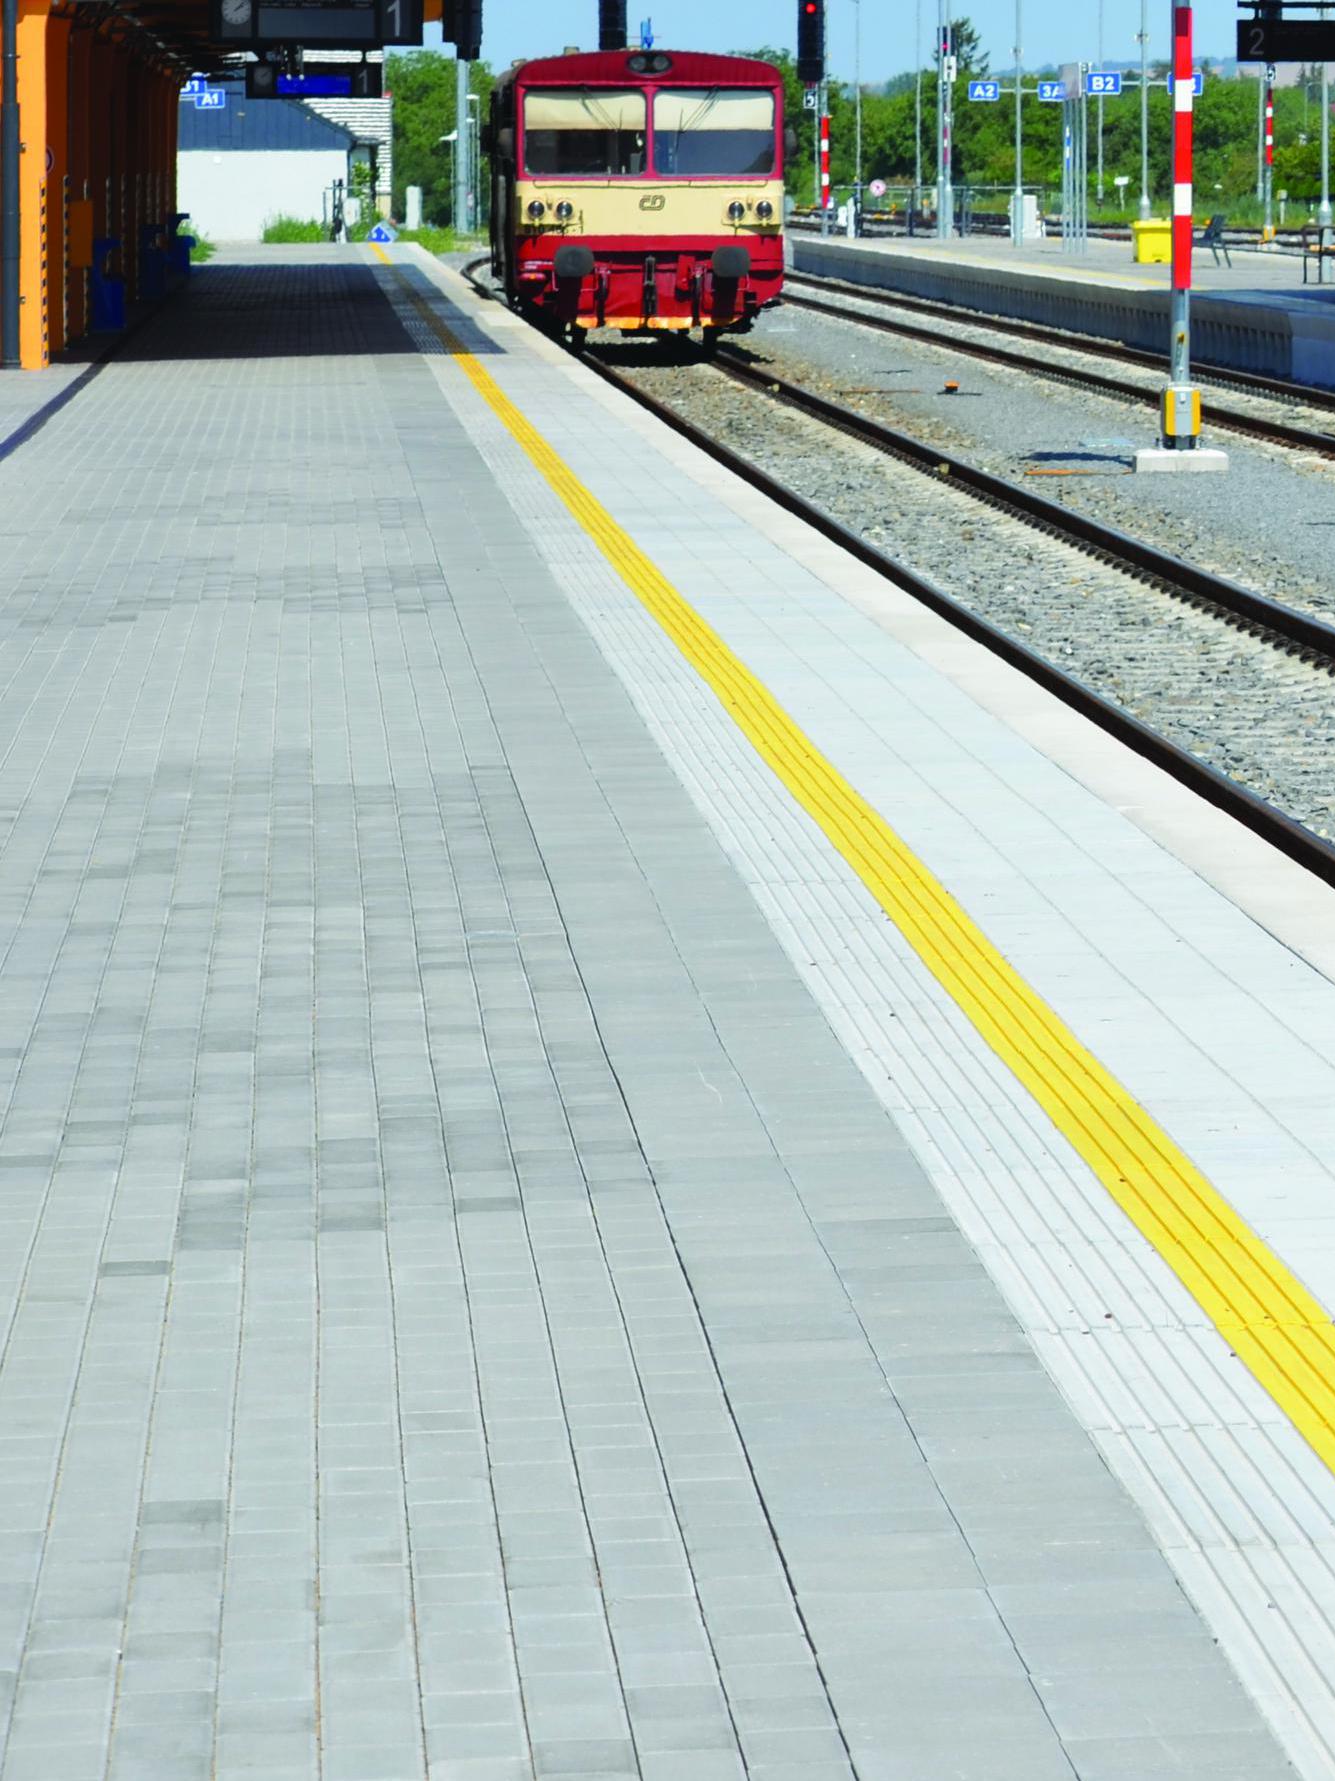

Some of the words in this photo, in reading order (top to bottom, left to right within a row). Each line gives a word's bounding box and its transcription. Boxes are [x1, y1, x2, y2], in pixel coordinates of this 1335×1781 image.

[386, 0, 401, 37] 1
[1249, 28, 1265, 55] 2
[358, 68, 368, 94] 1
[973, 85, 995, 97] A2
[1092, 76, 1115, 91] B2
[201, 93, 219, 105] A1
